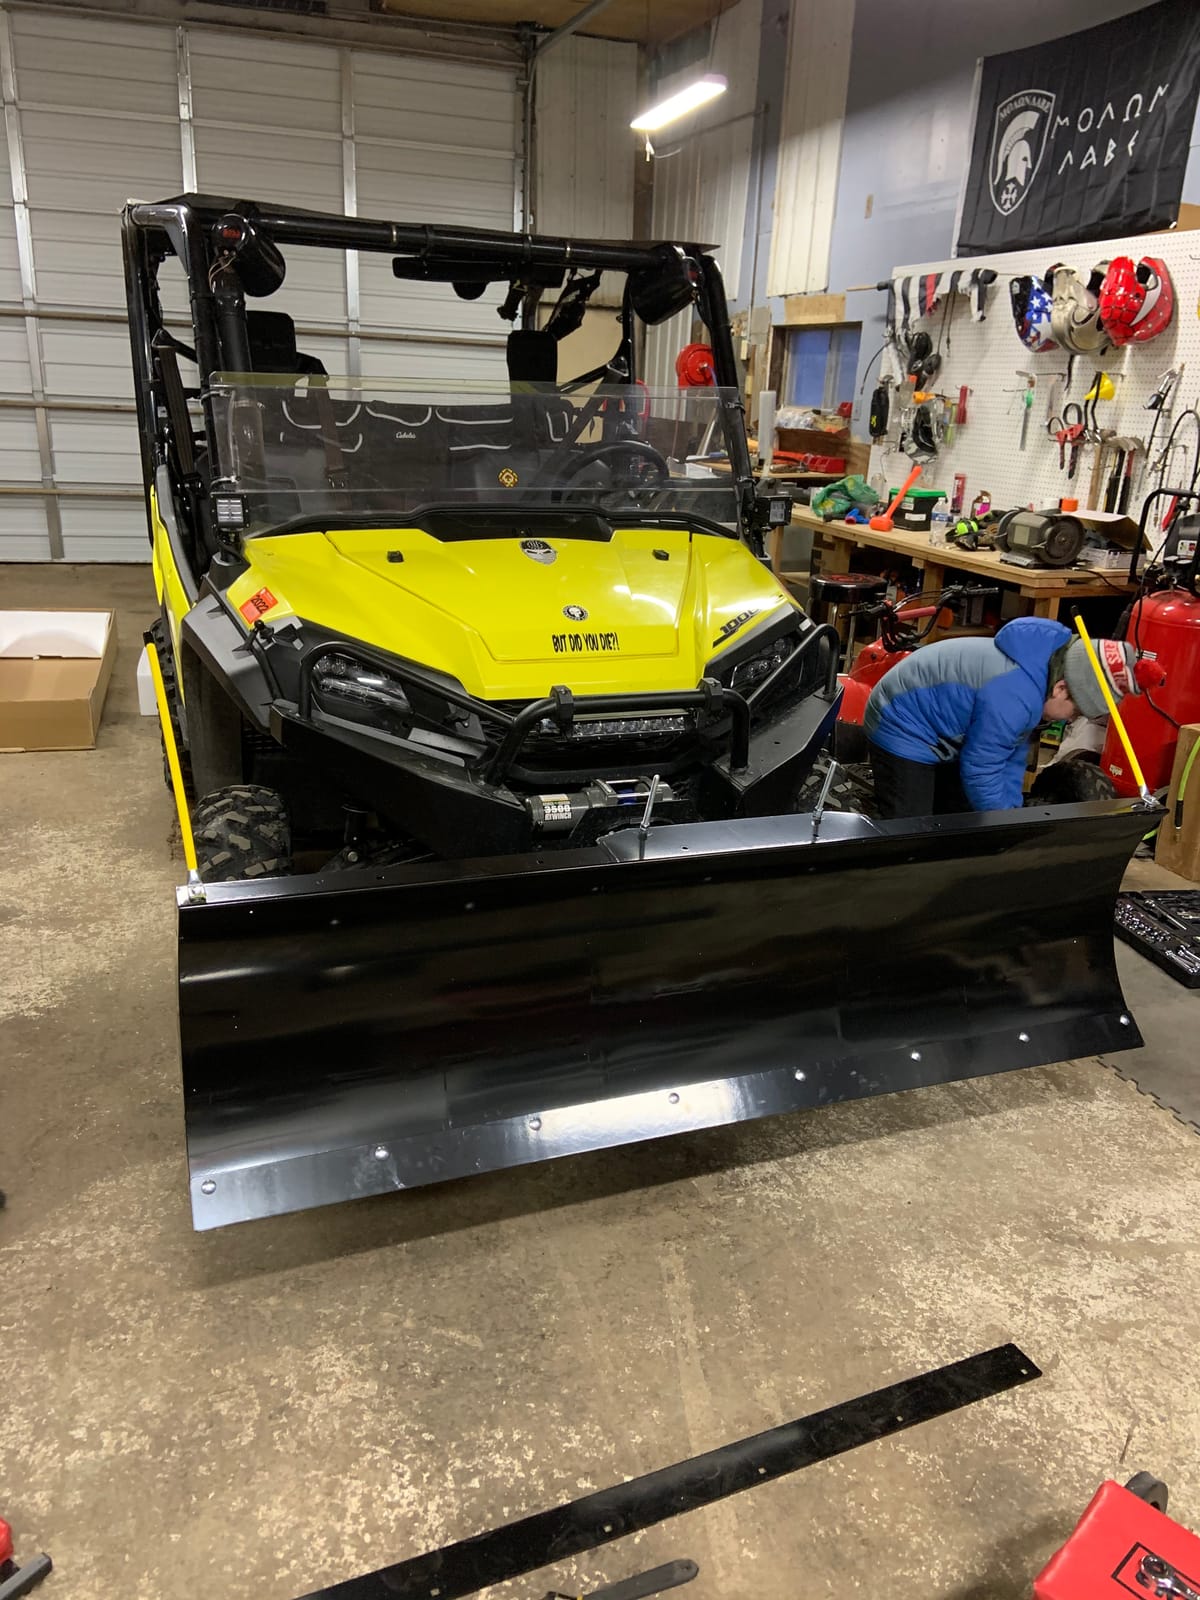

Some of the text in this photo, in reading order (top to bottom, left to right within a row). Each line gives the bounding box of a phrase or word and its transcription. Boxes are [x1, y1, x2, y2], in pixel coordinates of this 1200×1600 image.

[250, 594, 269, 614] 2022
[552, 631, 620, 653] BUT DID YOU DIE?!
[544, 804, 570, 814] 3500
